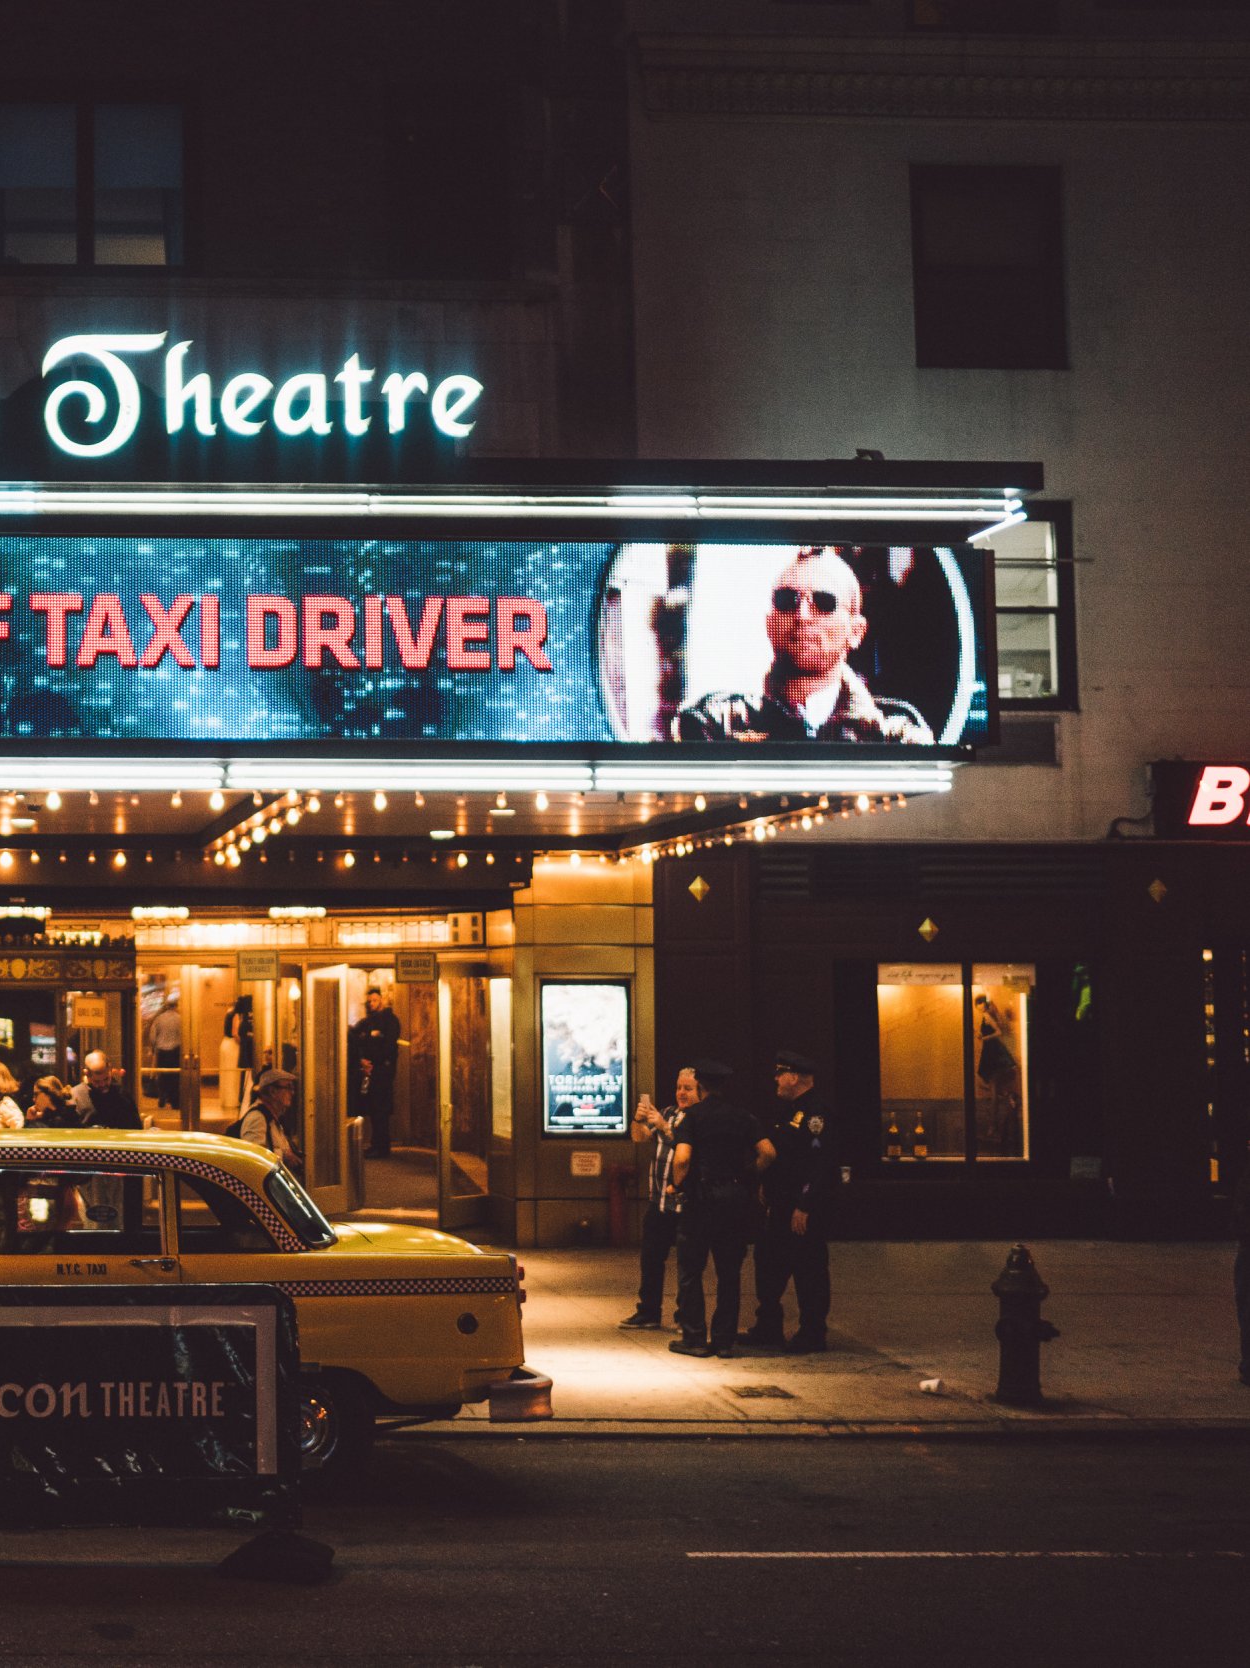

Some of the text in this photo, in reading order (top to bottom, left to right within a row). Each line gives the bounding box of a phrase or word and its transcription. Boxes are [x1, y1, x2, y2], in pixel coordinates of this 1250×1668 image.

[41, 329, 485, 459] Theatre
[29, 592, 220, 669] TAXI
[246, 593, 553, 671] DRIVER
[1187, 765, 1250, 827] B
[85, 1263, 108, 1276] TAXI
[99, 1381, 226, 1417] THEATRE
